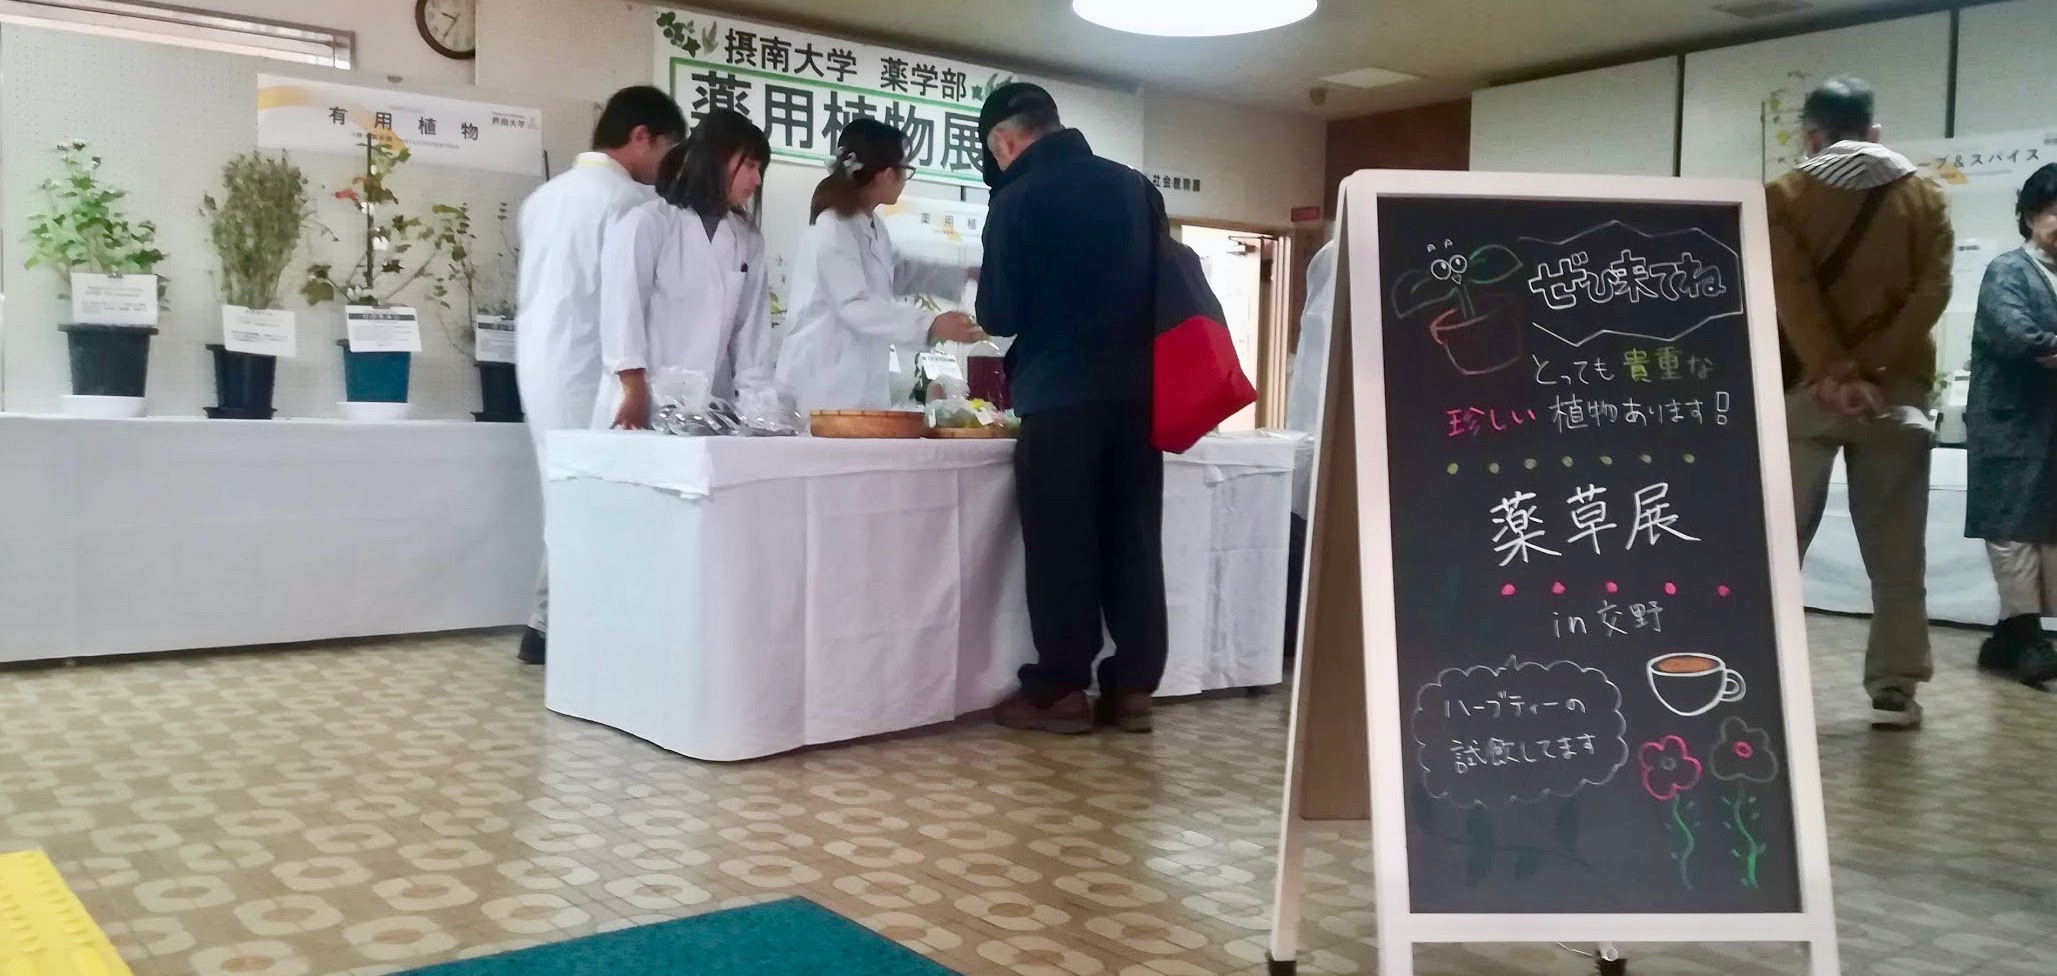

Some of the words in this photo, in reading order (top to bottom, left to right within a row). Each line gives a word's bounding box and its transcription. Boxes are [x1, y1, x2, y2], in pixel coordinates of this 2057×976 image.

[725, 27, 858, 82] 摂南大学
[880, 57, 967, 102] 薬学部
[328, 106, 479, 141] 有用植物
[1528, 249, 1727, 310] ぜひ来てね
[1531, 354, 1615, 386] とっても
[1623, 346, 1713, 383] 貴重な
[1446, 407, 1536, 438] 珍しい
[1488, 482, 1702, 567] 薬草展
[1551, 611, 1587, 639] in
[1596, 599, 1664, 637] 交野
[1443, 690, 1587, 718] ハーブティーの
[1449, 733, 1596, 775] 試飲してます
